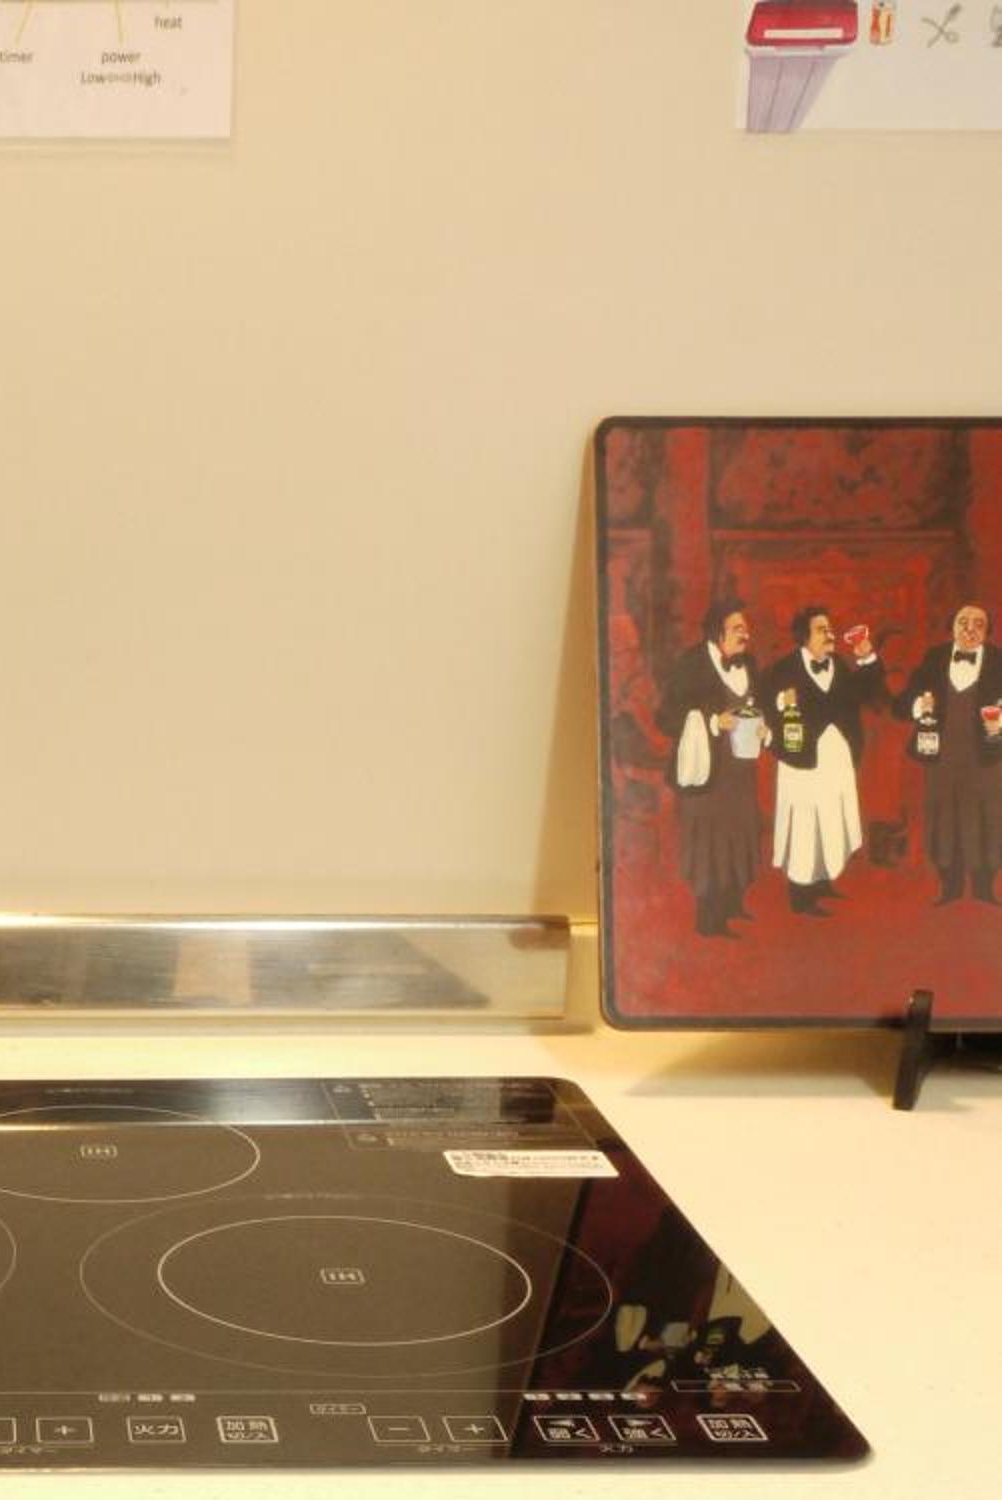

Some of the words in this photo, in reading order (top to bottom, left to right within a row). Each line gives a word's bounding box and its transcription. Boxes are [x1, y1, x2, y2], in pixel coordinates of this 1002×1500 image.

[153, 15, 183, 30] heat
[101, 51, 142, 65] power
[133, 1423, 179, 1435] 火力
